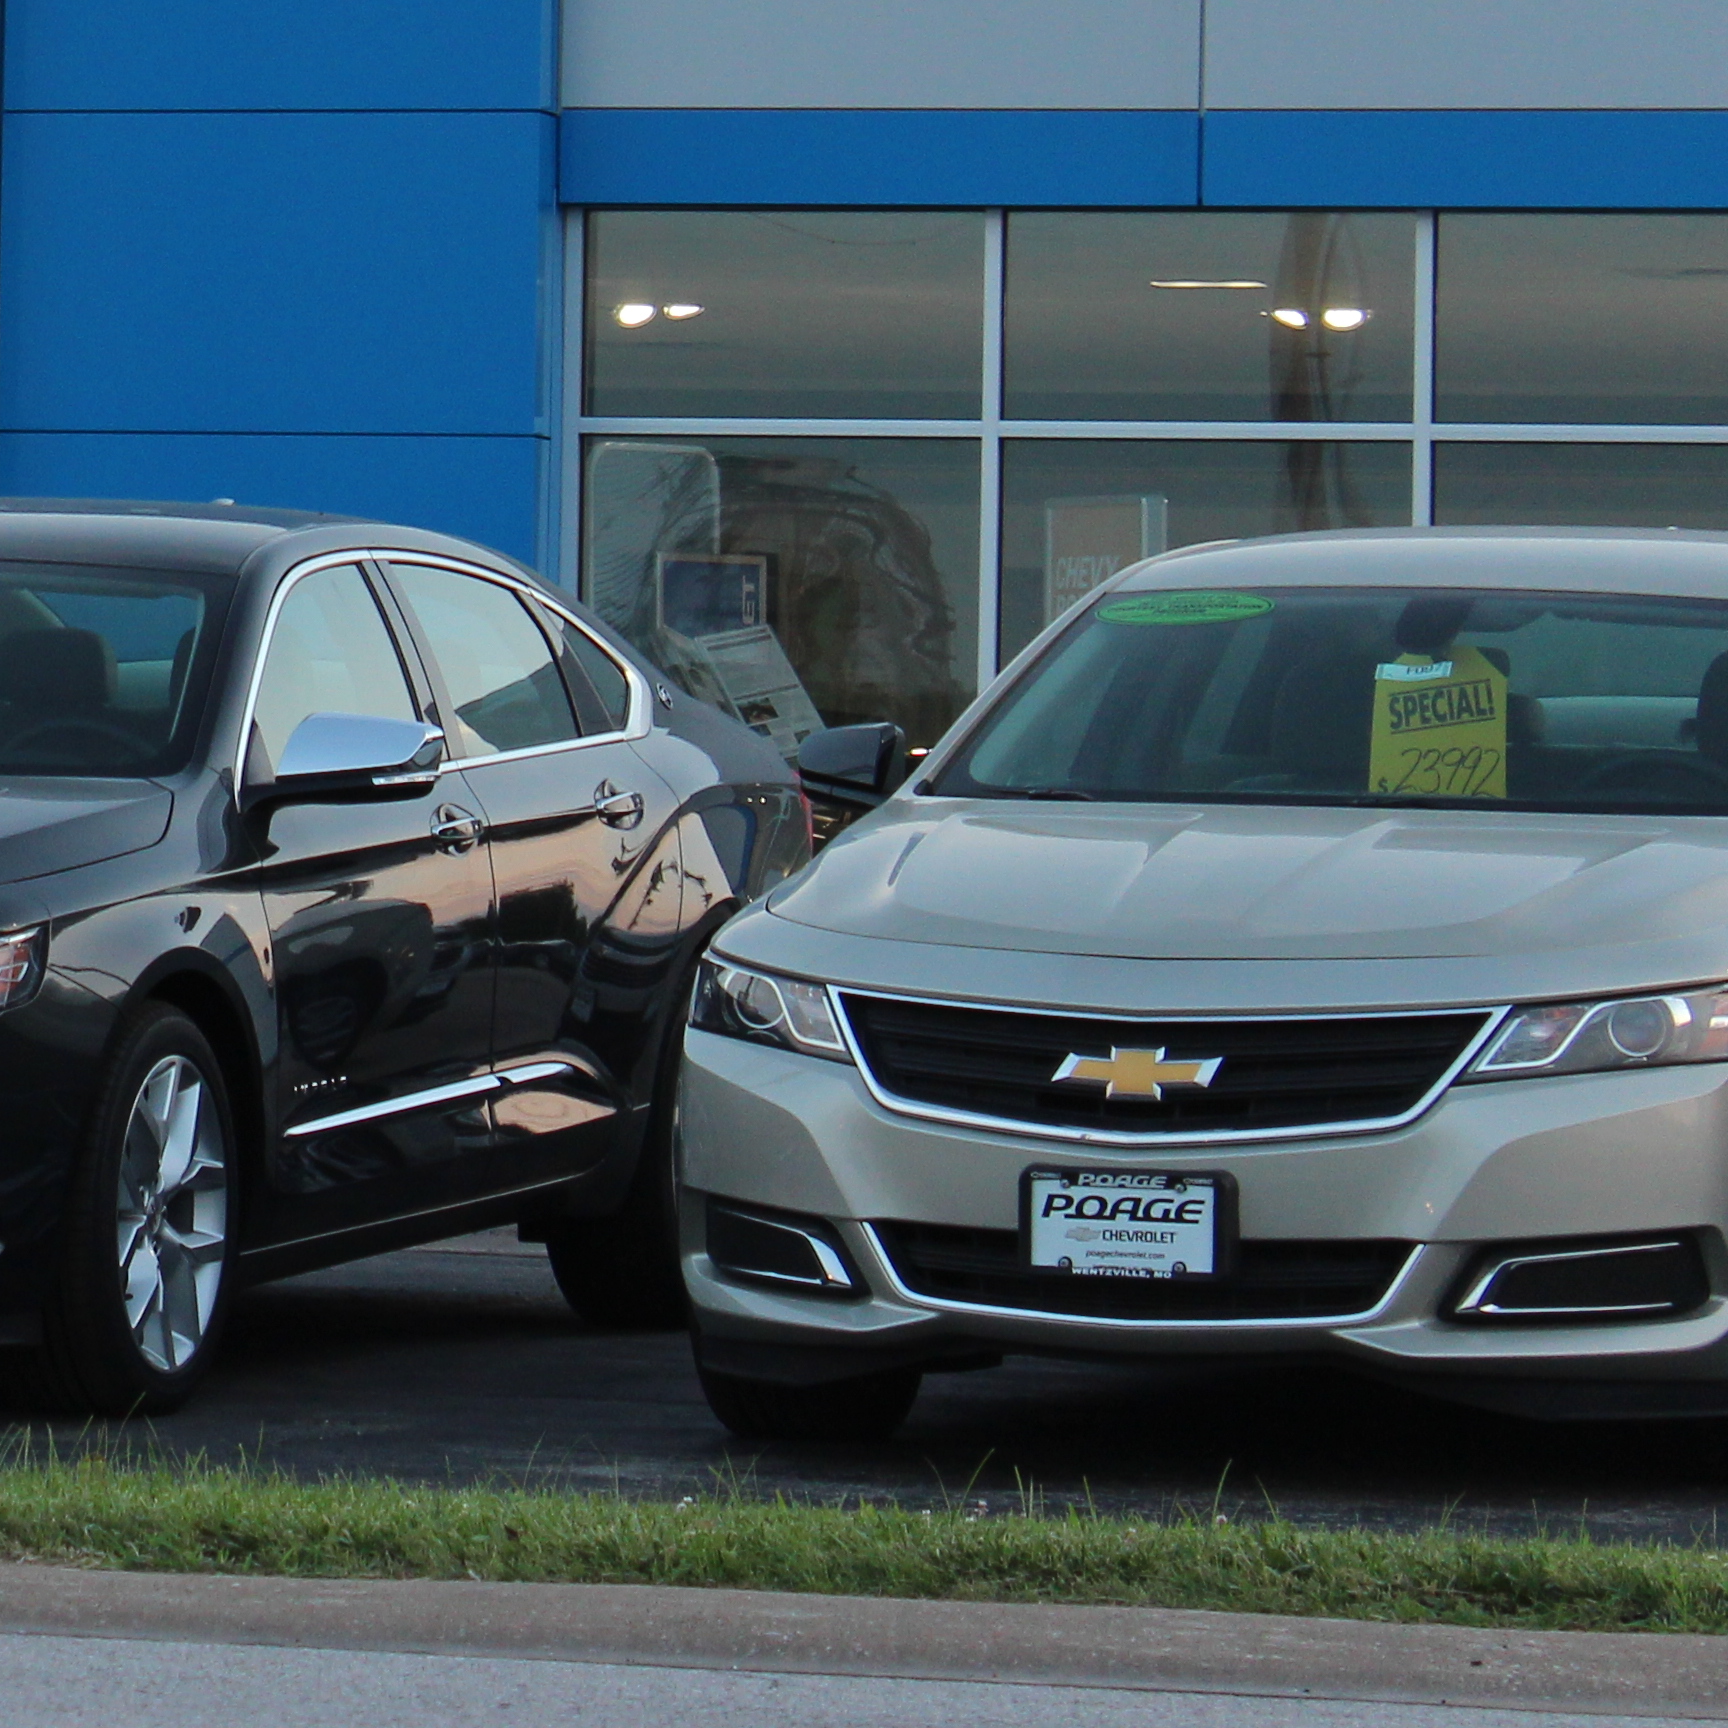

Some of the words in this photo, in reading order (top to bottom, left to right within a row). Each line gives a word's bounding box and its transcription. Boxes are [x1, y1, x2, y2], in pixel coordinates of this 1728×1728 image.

[1389, 680, 1495, 730] SPECIAL!
[1078, 1173, 1167, 1189] POAGE
[1041, 1193, 1206, 1224] POAGE
[1102, 1229, 1176, 1244] CHEVROLET
[1072, 1267, 1150, 1279] WENTZVILLE,
[1153, 1270, 1172, 1279] MO
